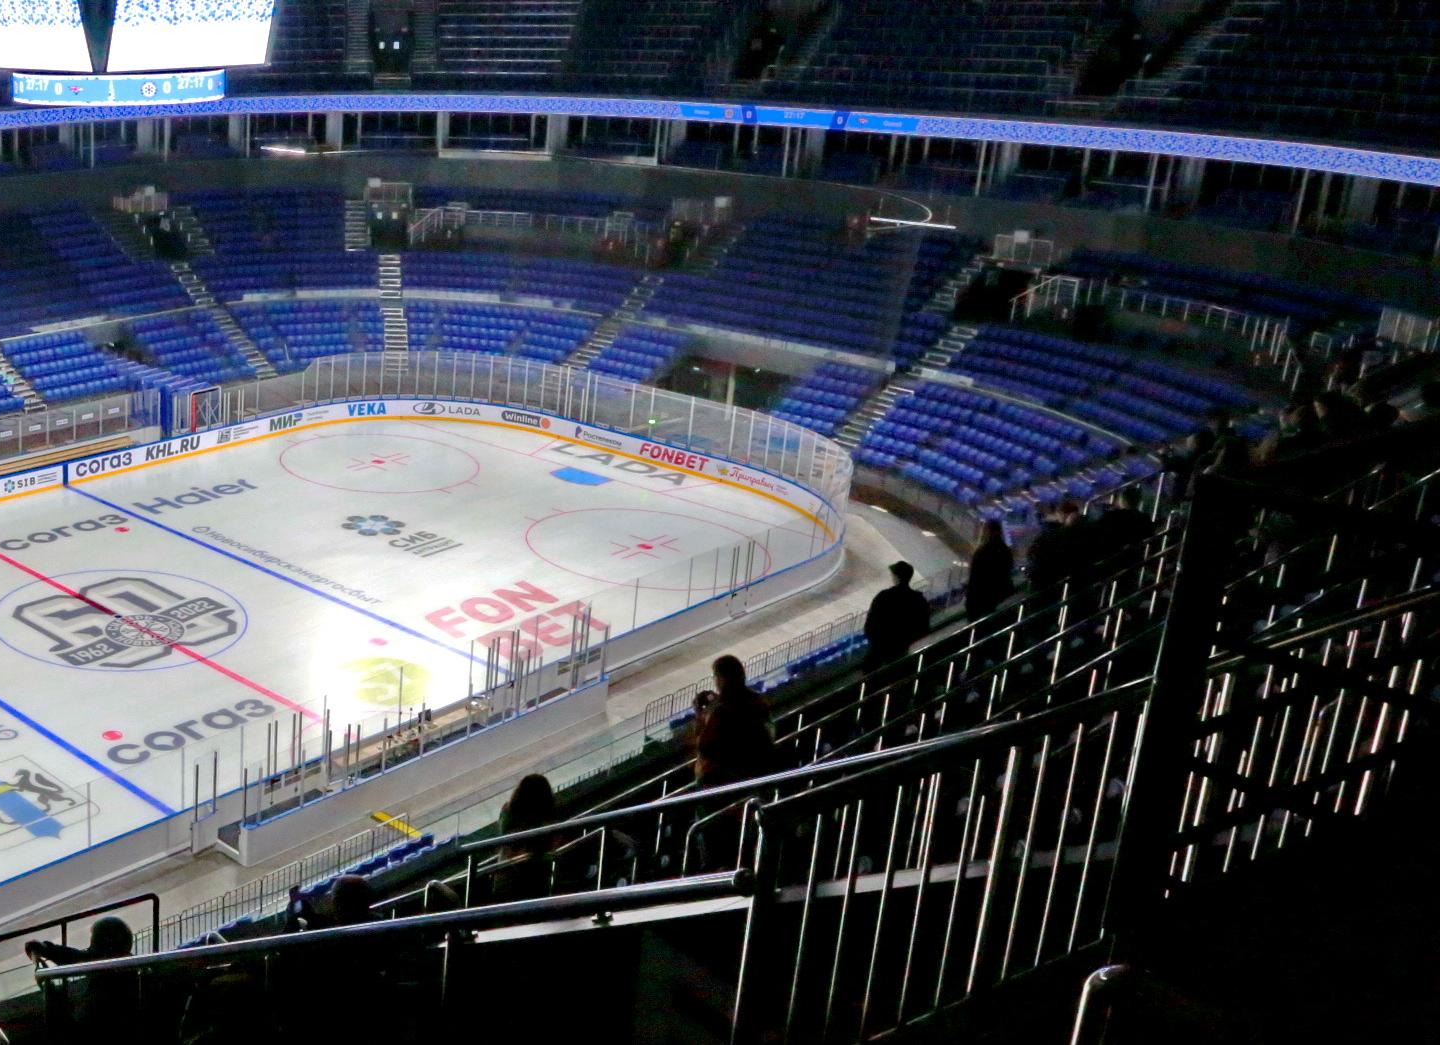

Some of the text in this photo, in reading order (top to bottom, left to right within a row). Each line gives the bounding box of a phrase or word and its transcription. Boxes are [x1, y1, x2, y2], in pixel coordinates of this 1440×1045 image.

[177, 76, 205, 90] 27:17
[347, 402, 387, 416] VEKA
[448, 405, 481, 416] LADA
[504, 411, 539, 426] Winline
[269, 412, 304, 432] МИР
[145, 435, 201, 461] KHL.RU
[639, 442, 710, 471] FONBET
[550, 443, 689, 486] LADA
[132, 478, 258, 515] Haier
[171, 600, 215, 619] 2022
[425, 580, 559, 639] FON
[71, 643, 114, 662] 1962
